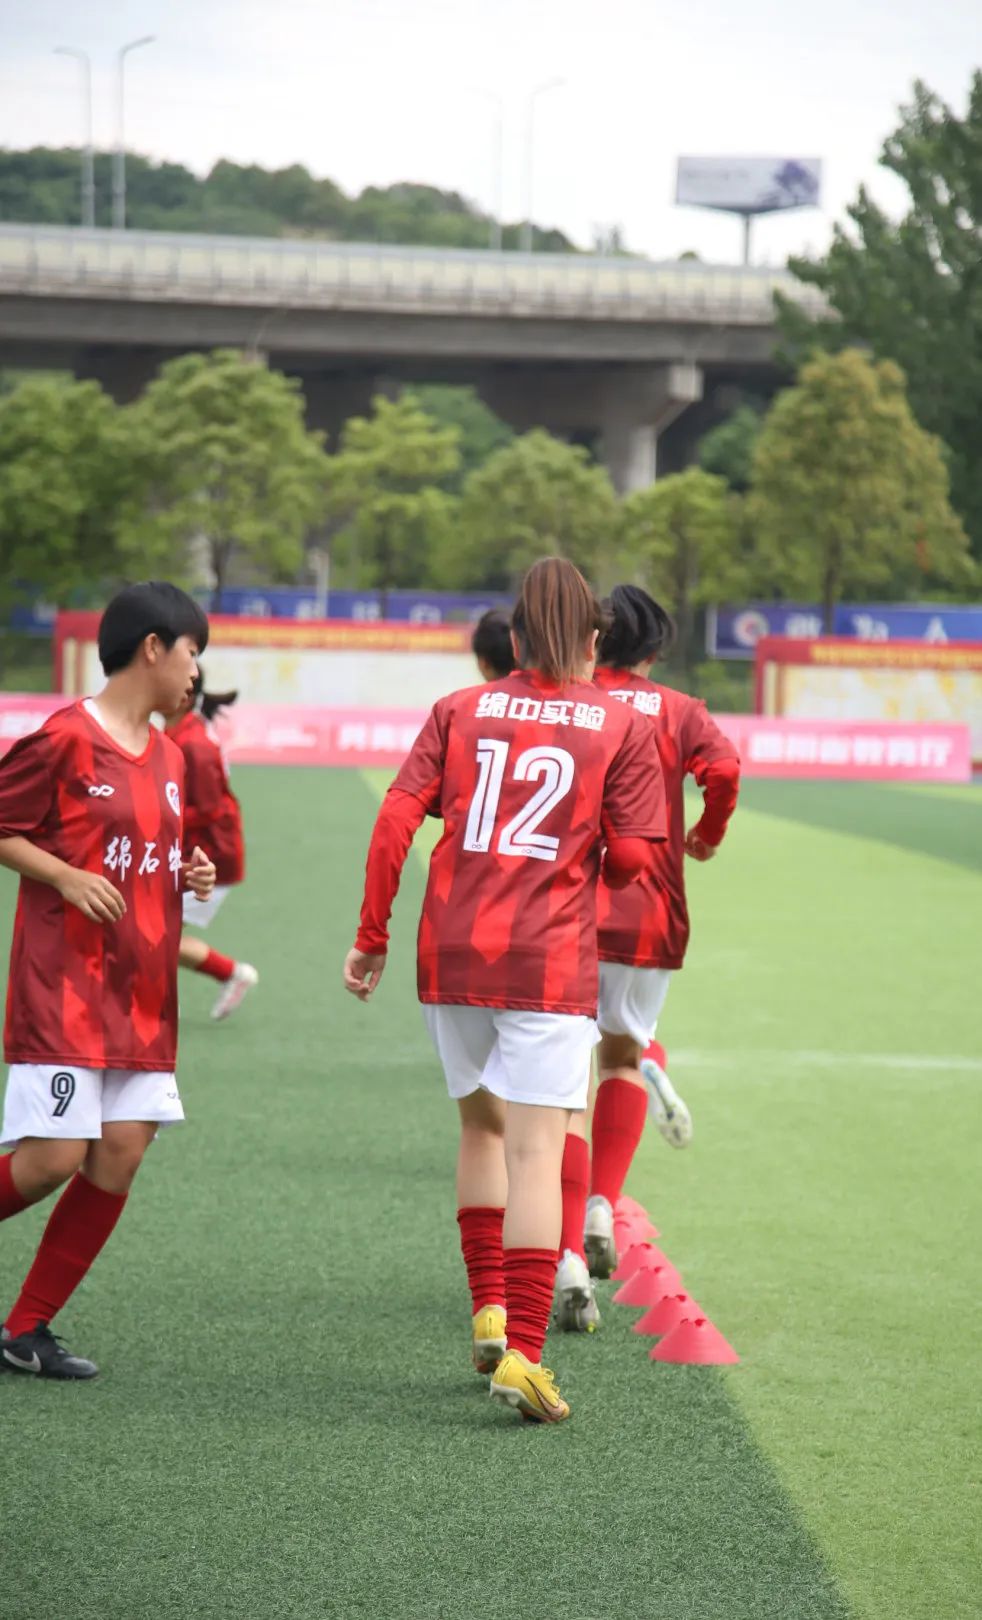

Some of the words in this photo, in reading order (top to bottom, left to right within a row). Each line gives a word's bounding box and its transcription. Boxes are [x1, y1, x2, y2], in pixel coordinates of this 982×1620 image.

[474, 691, 607, 732] 绵中实验
[463, 739, 575, 861] 12
[51, 1072, 75, 1117] 9
